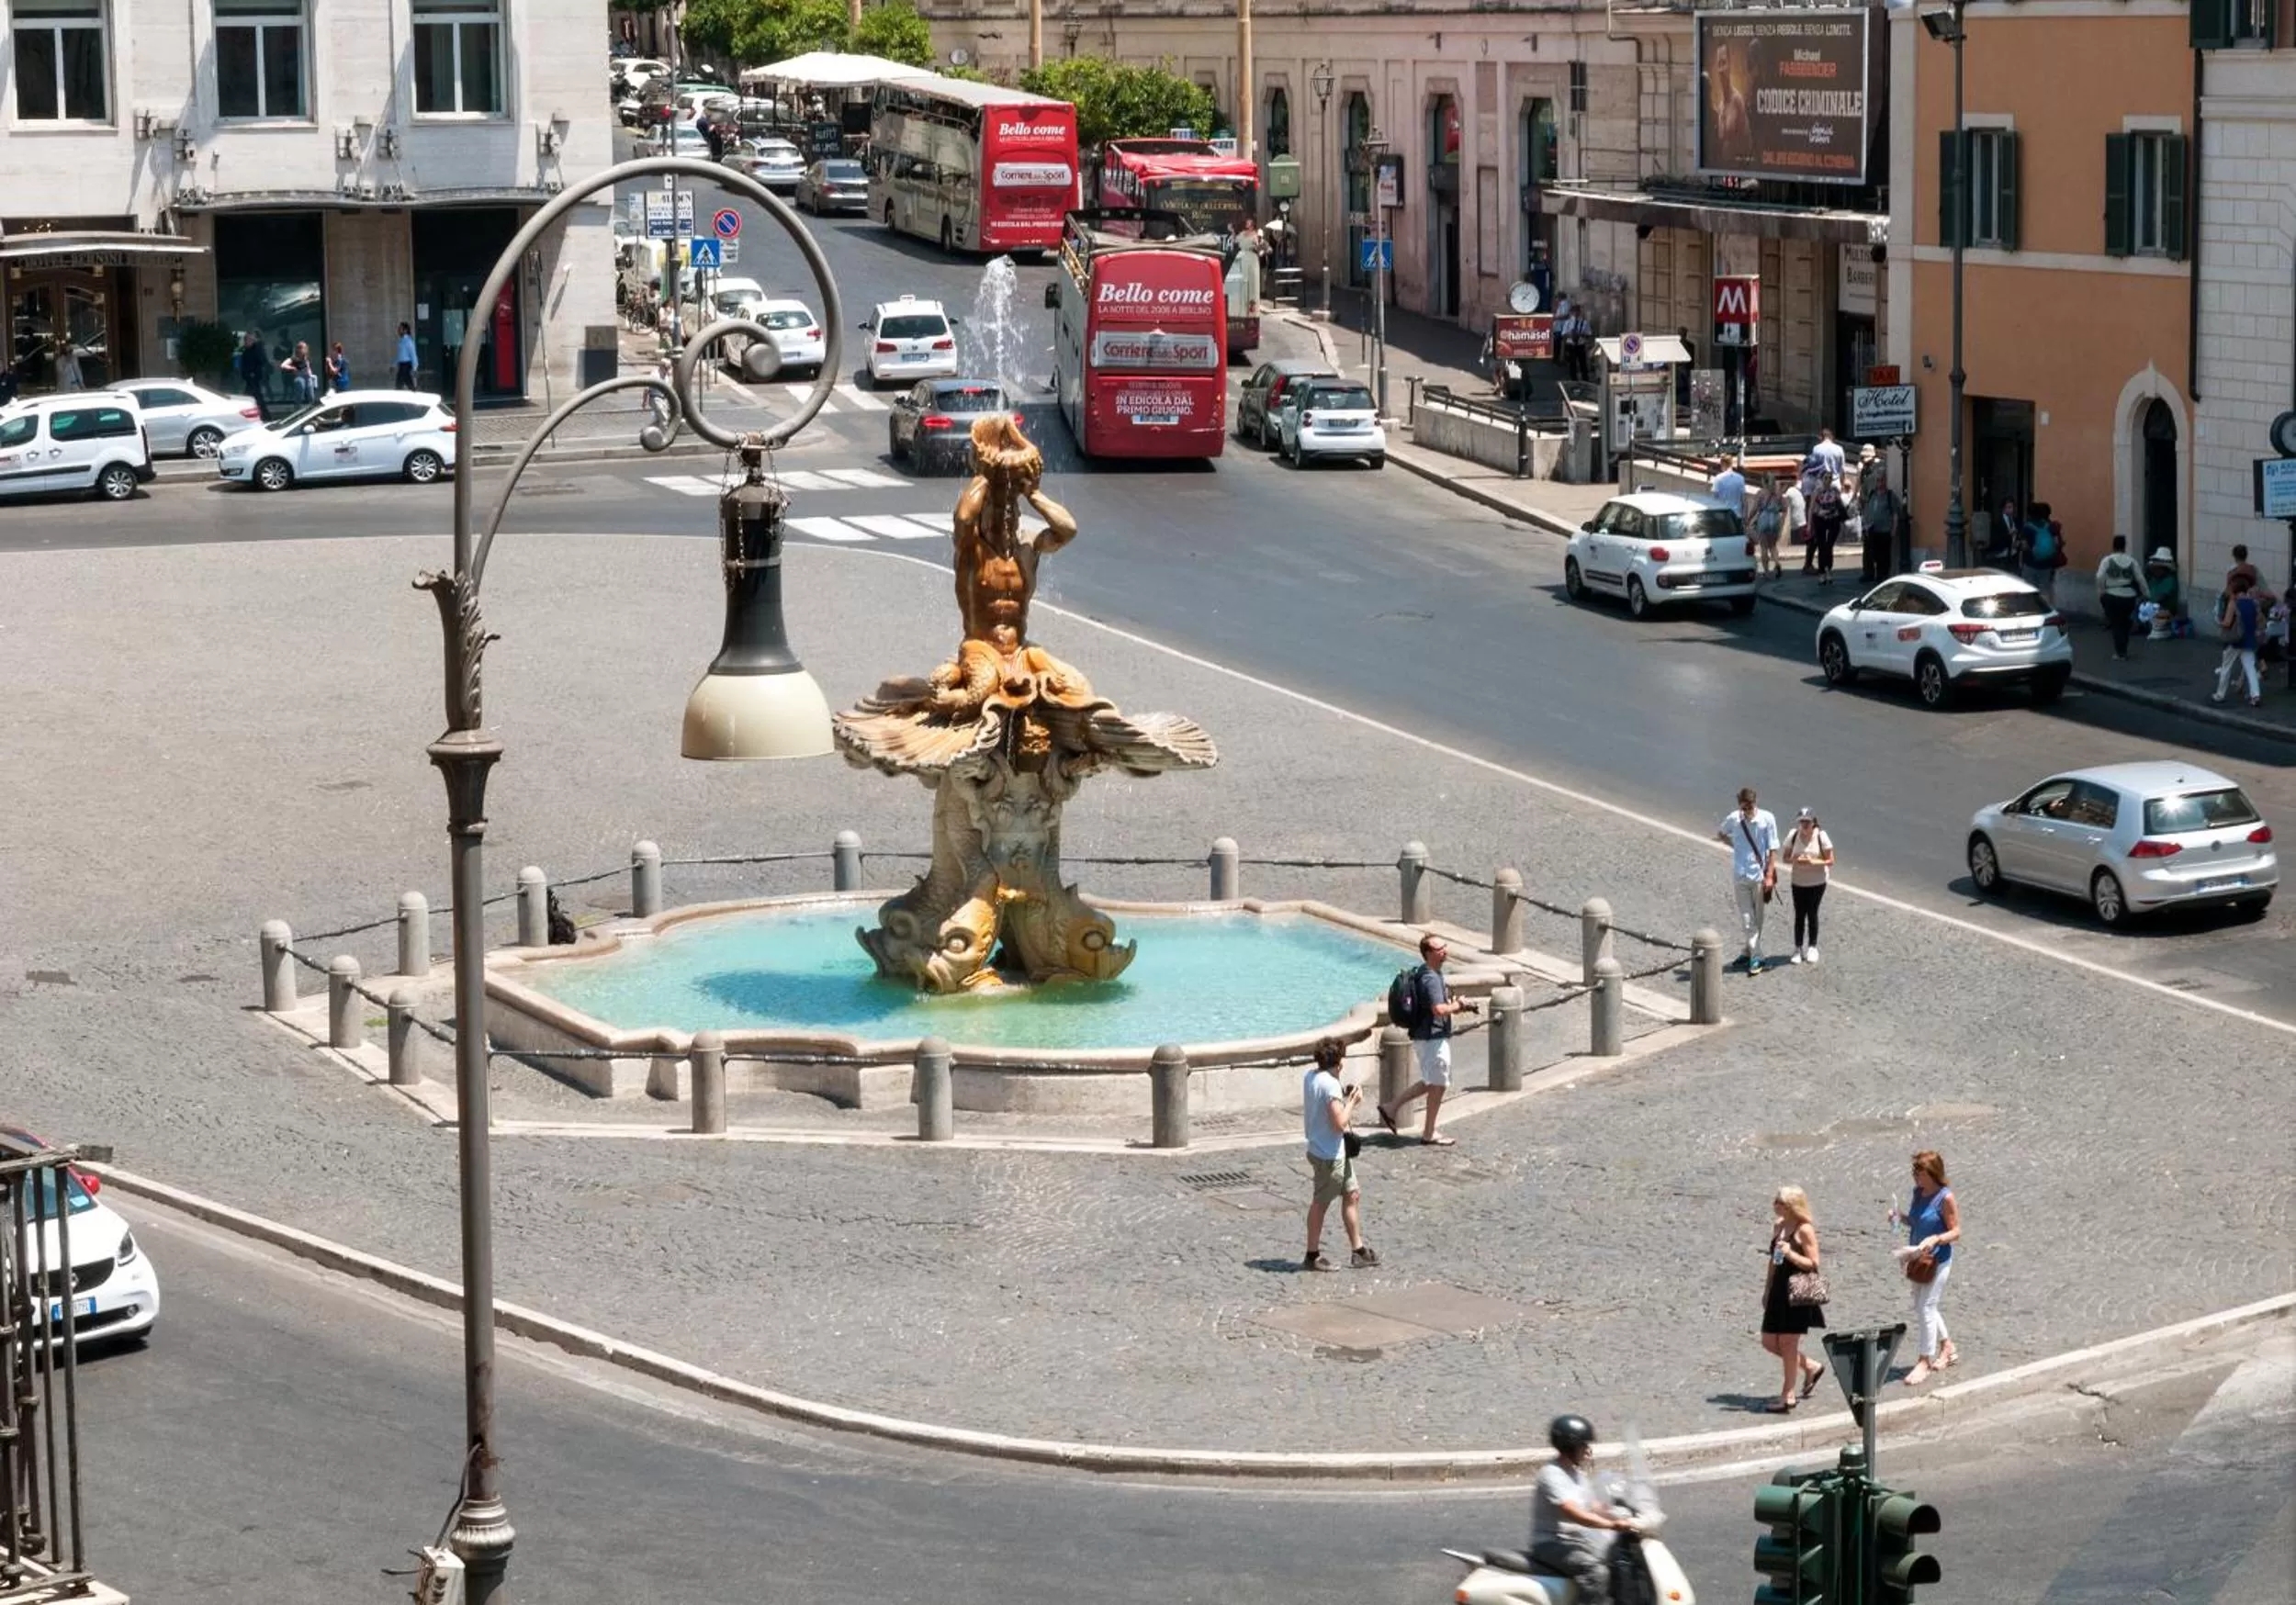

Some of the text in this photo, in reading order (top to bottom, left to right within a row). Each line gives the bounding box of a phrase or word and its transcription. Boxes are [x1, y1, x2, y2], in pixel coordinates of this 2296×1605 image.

[1794, 49, 1821, 62] Michael
[1757, 88, 1863, 117] CODICE CRIMINALE
[999, 122, 1065, 136] Bello come
[1042, 171, 1065, 182] Sport
[1097, 282, 1214, 304] Bello come
[1717, 285, 1748, 314] M
[1097, 306, 1109, 314] LA
[1110, 306, 1135, 314] NOTTE
[1103, 342, 1153, 358] Corriere
[1174, 343, 1209, 363] Sport
[1116, 396, 1194, 405] IN EDICOLA DAL
[1858, 388, 1911, 408] Hotel
[1117, 405, 1193, 415] PRIMO GIUGNO.
